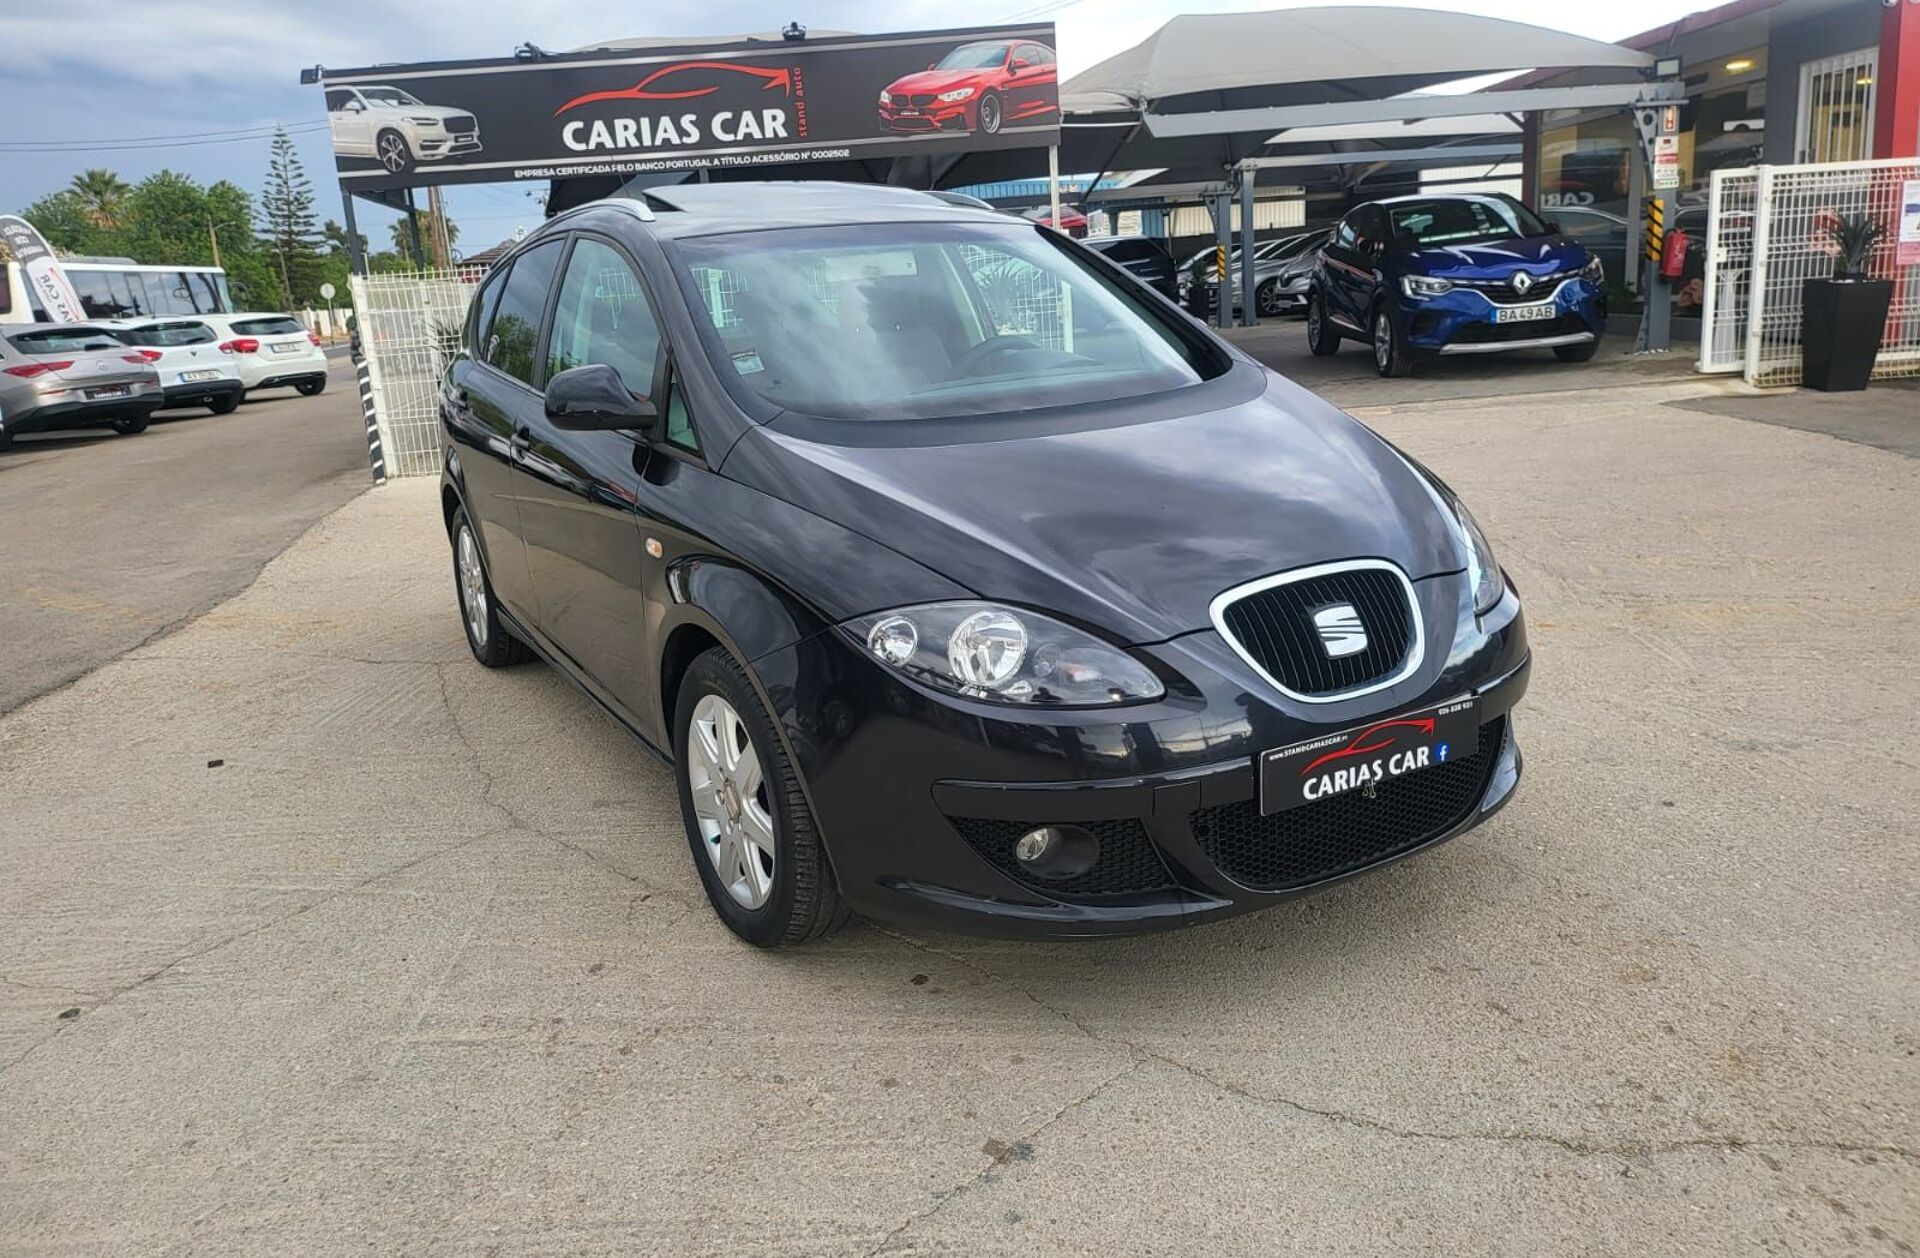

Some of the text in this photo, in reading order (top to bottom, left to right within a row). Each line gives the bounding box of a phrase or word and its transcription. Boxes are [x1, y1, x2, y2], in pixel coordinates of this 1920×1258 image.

[793, 67, 807, 137] stand auto
[562, 108, 788, 151] CARIAS CAR
[514, 167, 555, 179] EMPRESA
[556, 164, 611, 176] CERTIFICADA
[635, 160, 664, 171] BANCO
[665, 157, 712, 169] PORTUGAL
[713, 157, 720, 165] A
[720, 155, 751, 166] TÍTULO
[752, 151, 800, 164] ACESSÓRIO
[1302, 759, 1383, 800] CARIAS
[1388, 746, 1430, 775] CAR
